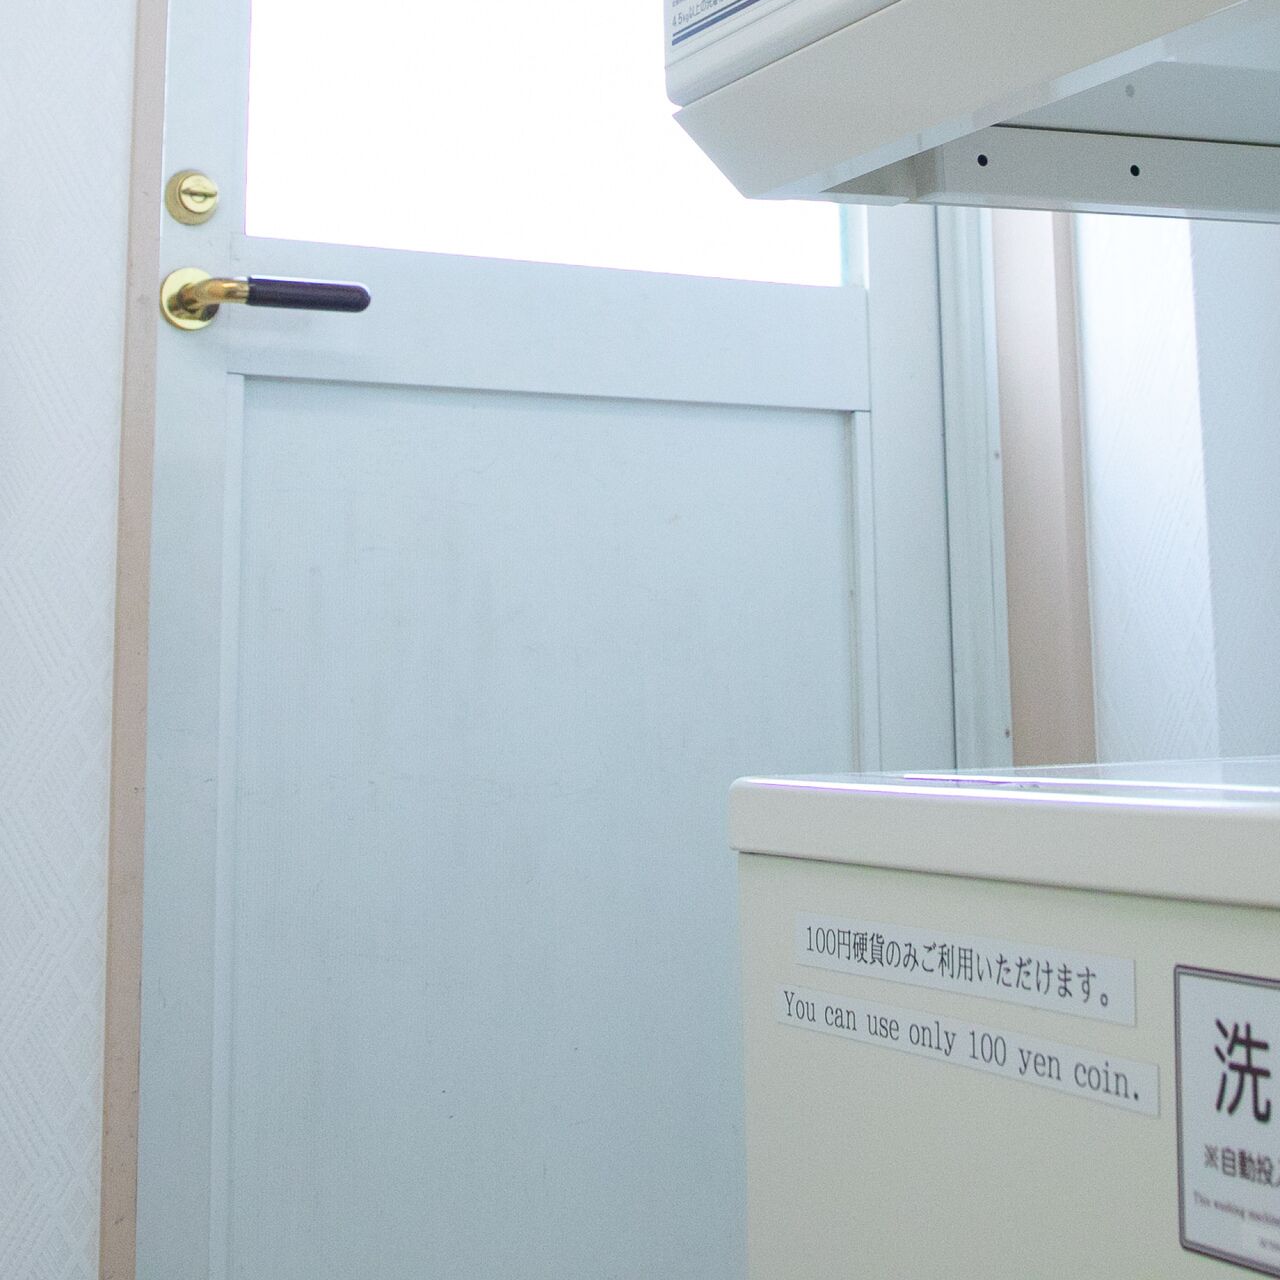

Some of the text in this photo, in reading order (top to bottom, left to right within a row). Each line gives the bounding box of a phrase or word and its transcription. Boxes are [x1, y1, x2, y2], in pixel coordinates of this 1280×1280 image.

[806, 926, 1109, 1008] 100円硬貨のみご利用いただけます。
[784, 990, 1140, 1101] You can use only 100 yen coin.
